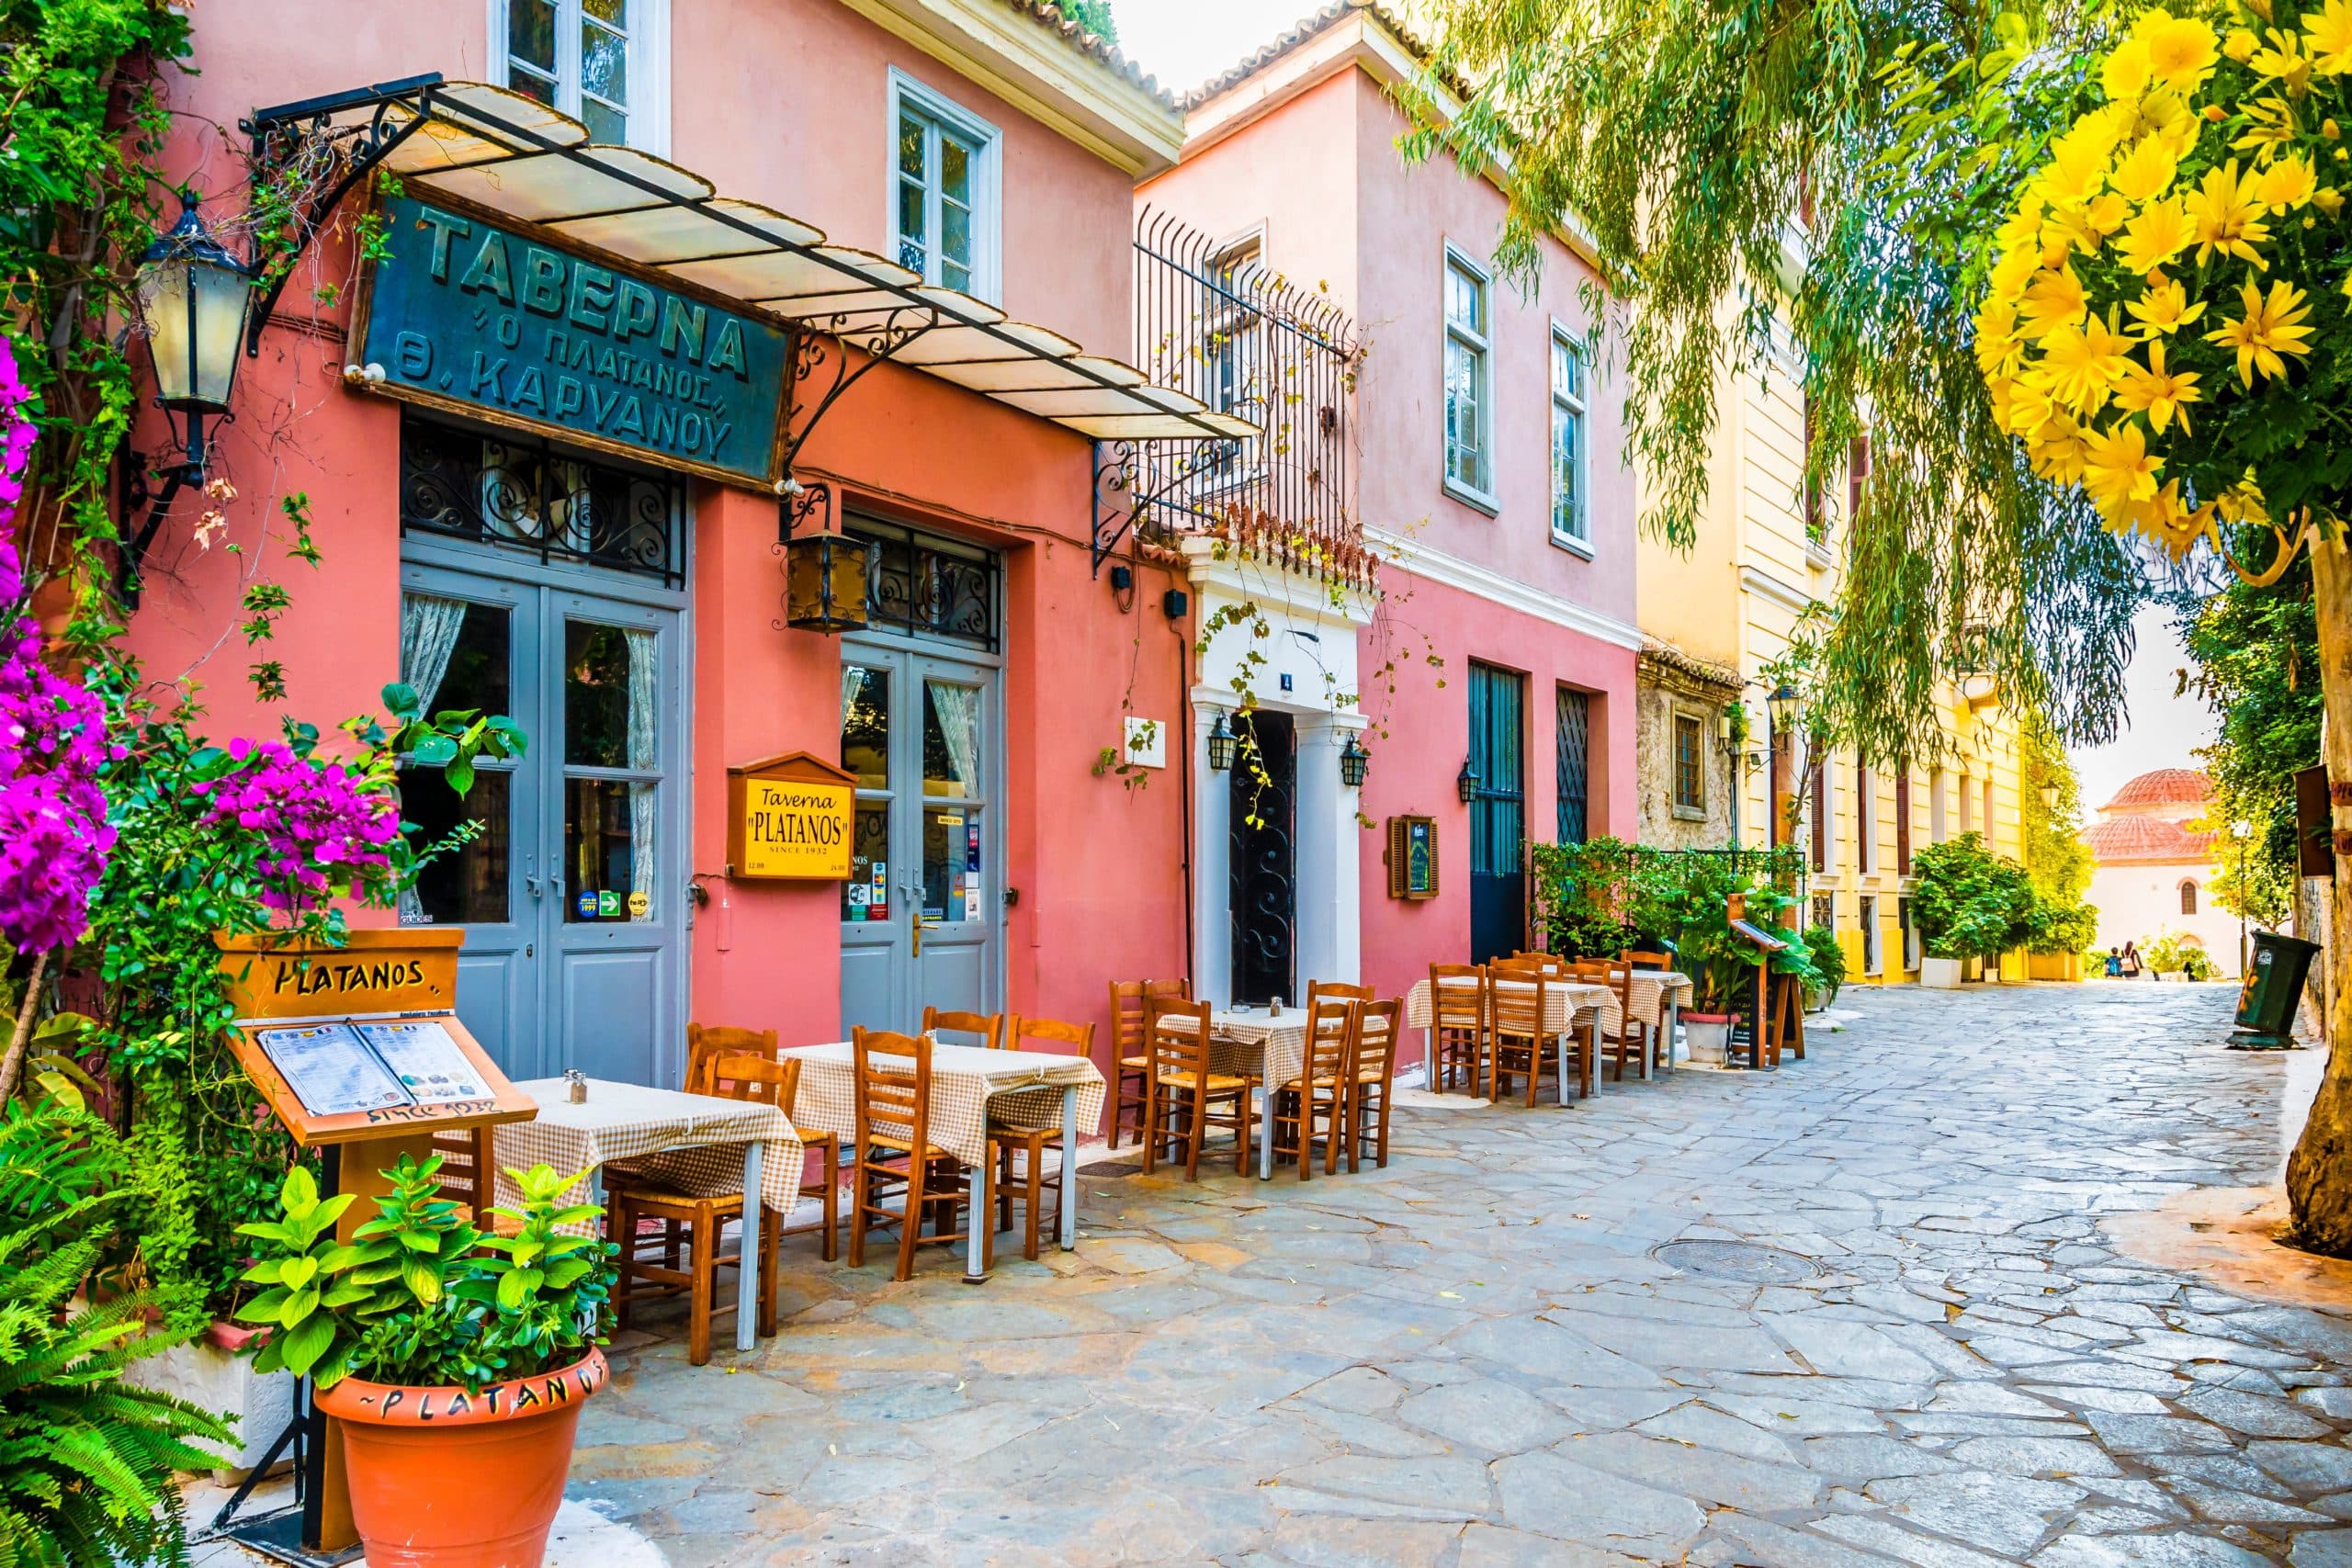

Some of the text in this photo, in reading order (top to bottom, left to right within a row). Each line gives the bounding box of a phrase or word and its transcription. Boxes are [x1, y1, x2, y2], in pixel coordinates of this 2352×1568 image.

[420, 205, 749, 381] ΤΑΒΕΡΝΑ
[470, 351, 731, 461] ΚΑΡΥΑΝΟΥ
[762, 787, 838, 809] Taverna
[747, 811, 848, 846] "PLATANOS"
[769, 846, 828, 855] SINCE 1932
